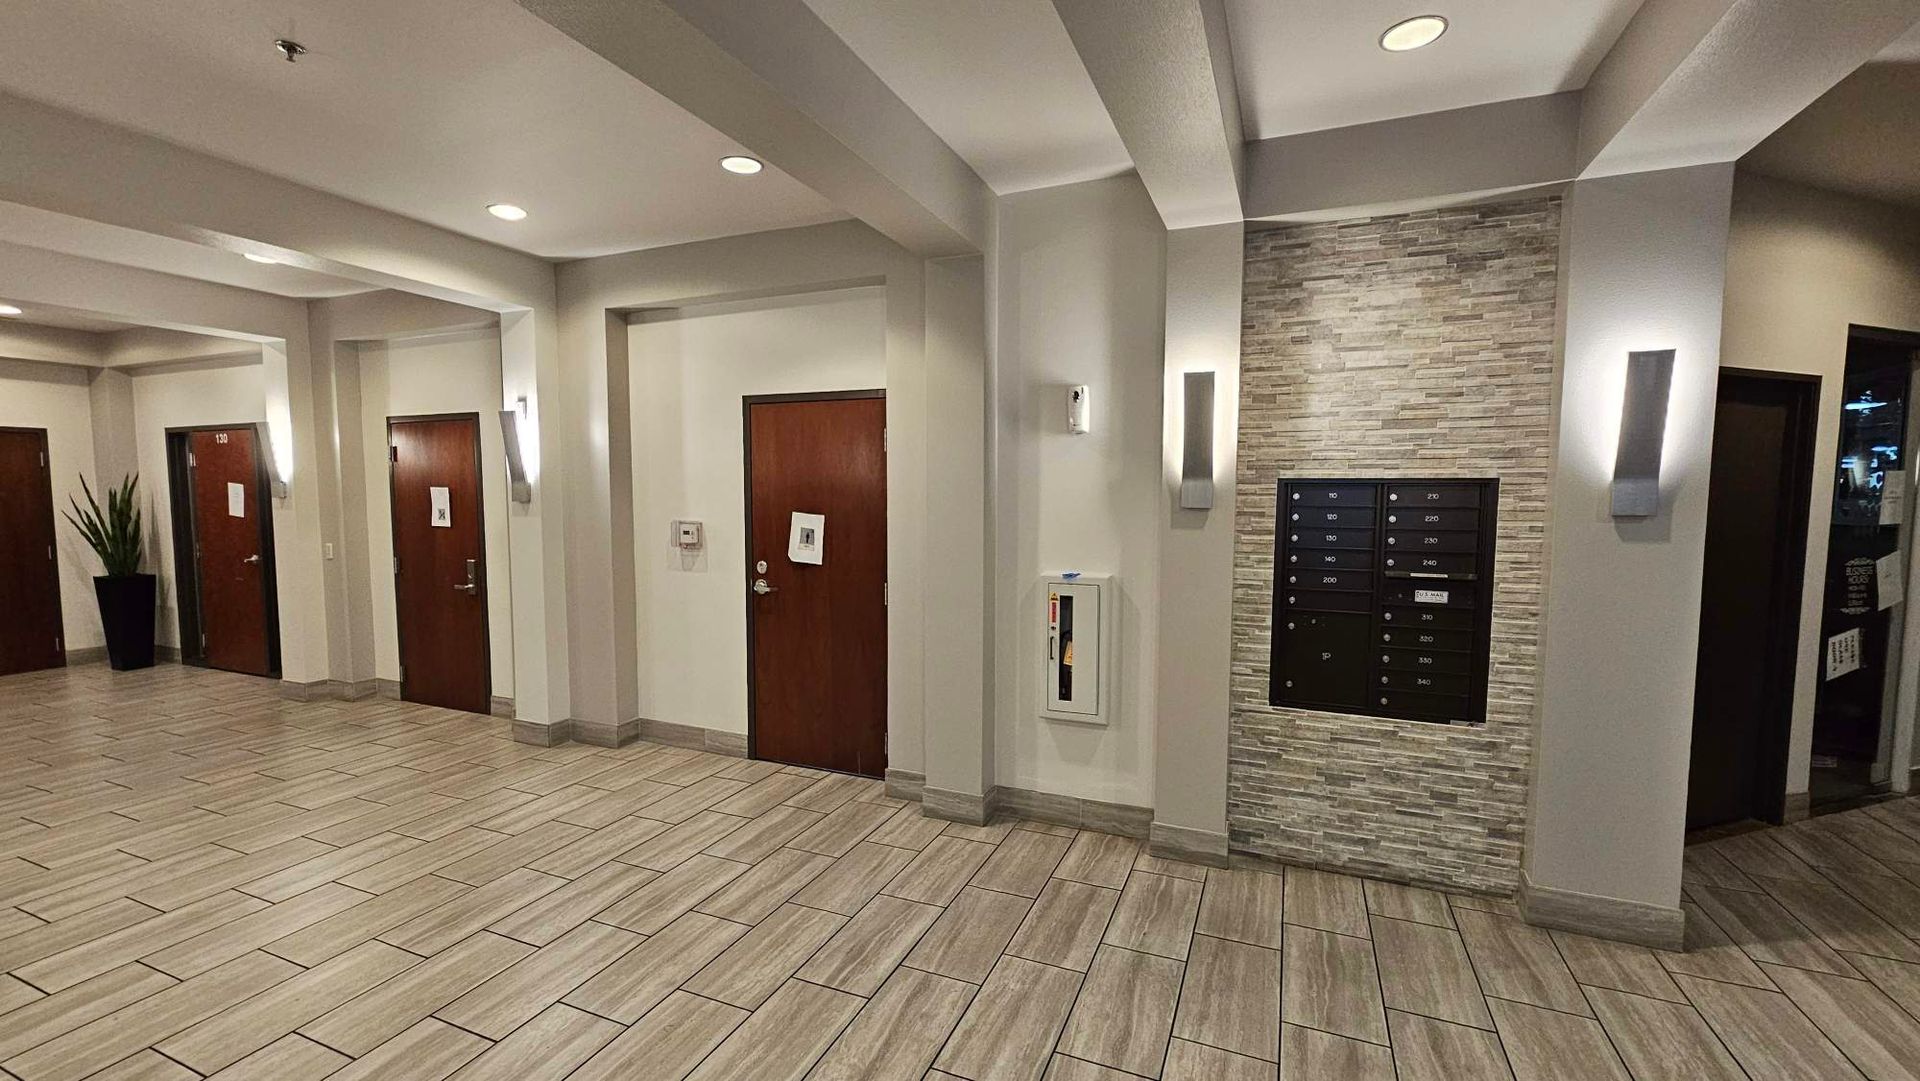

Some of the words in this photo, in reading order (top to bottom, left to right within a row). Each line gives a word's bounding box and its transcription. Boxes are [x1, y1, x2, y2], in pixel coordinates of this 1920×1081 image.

[215, 433, 228, 444] 130
[1326, 513, 1338, 521] 120
[1325, 534, 1337, 542] 130
[1322, 576, 1338, 584] 200
[1419, 635, 1434, 643] 320
[1321, 652, 1332, 661] 1P
[1418, 657, 1433, 665] 330
[1416, 678, 1431, 686] 340
